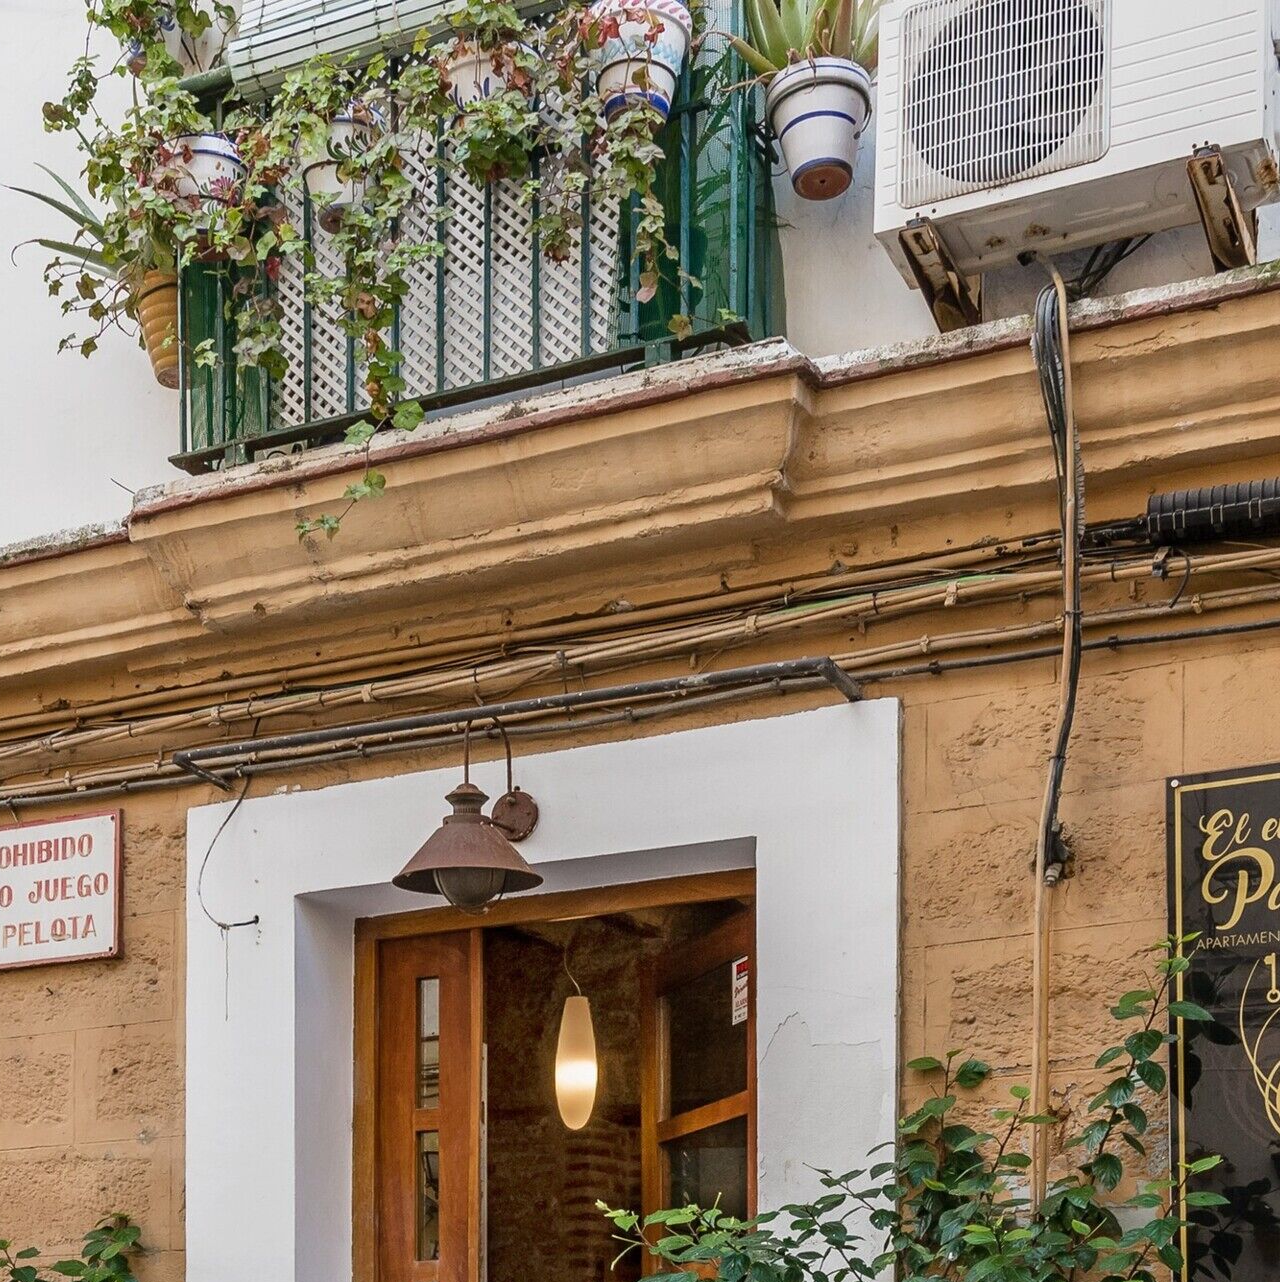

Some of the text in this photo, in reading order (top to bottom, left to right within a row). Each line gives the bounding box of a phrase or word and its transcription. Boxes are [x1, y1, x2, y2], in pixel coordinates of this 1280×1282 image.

[1199, 808, 1251, 861] El
[27, 873, 109, 904] JUEGO
[2, 913, 98, 949] PELOTA
